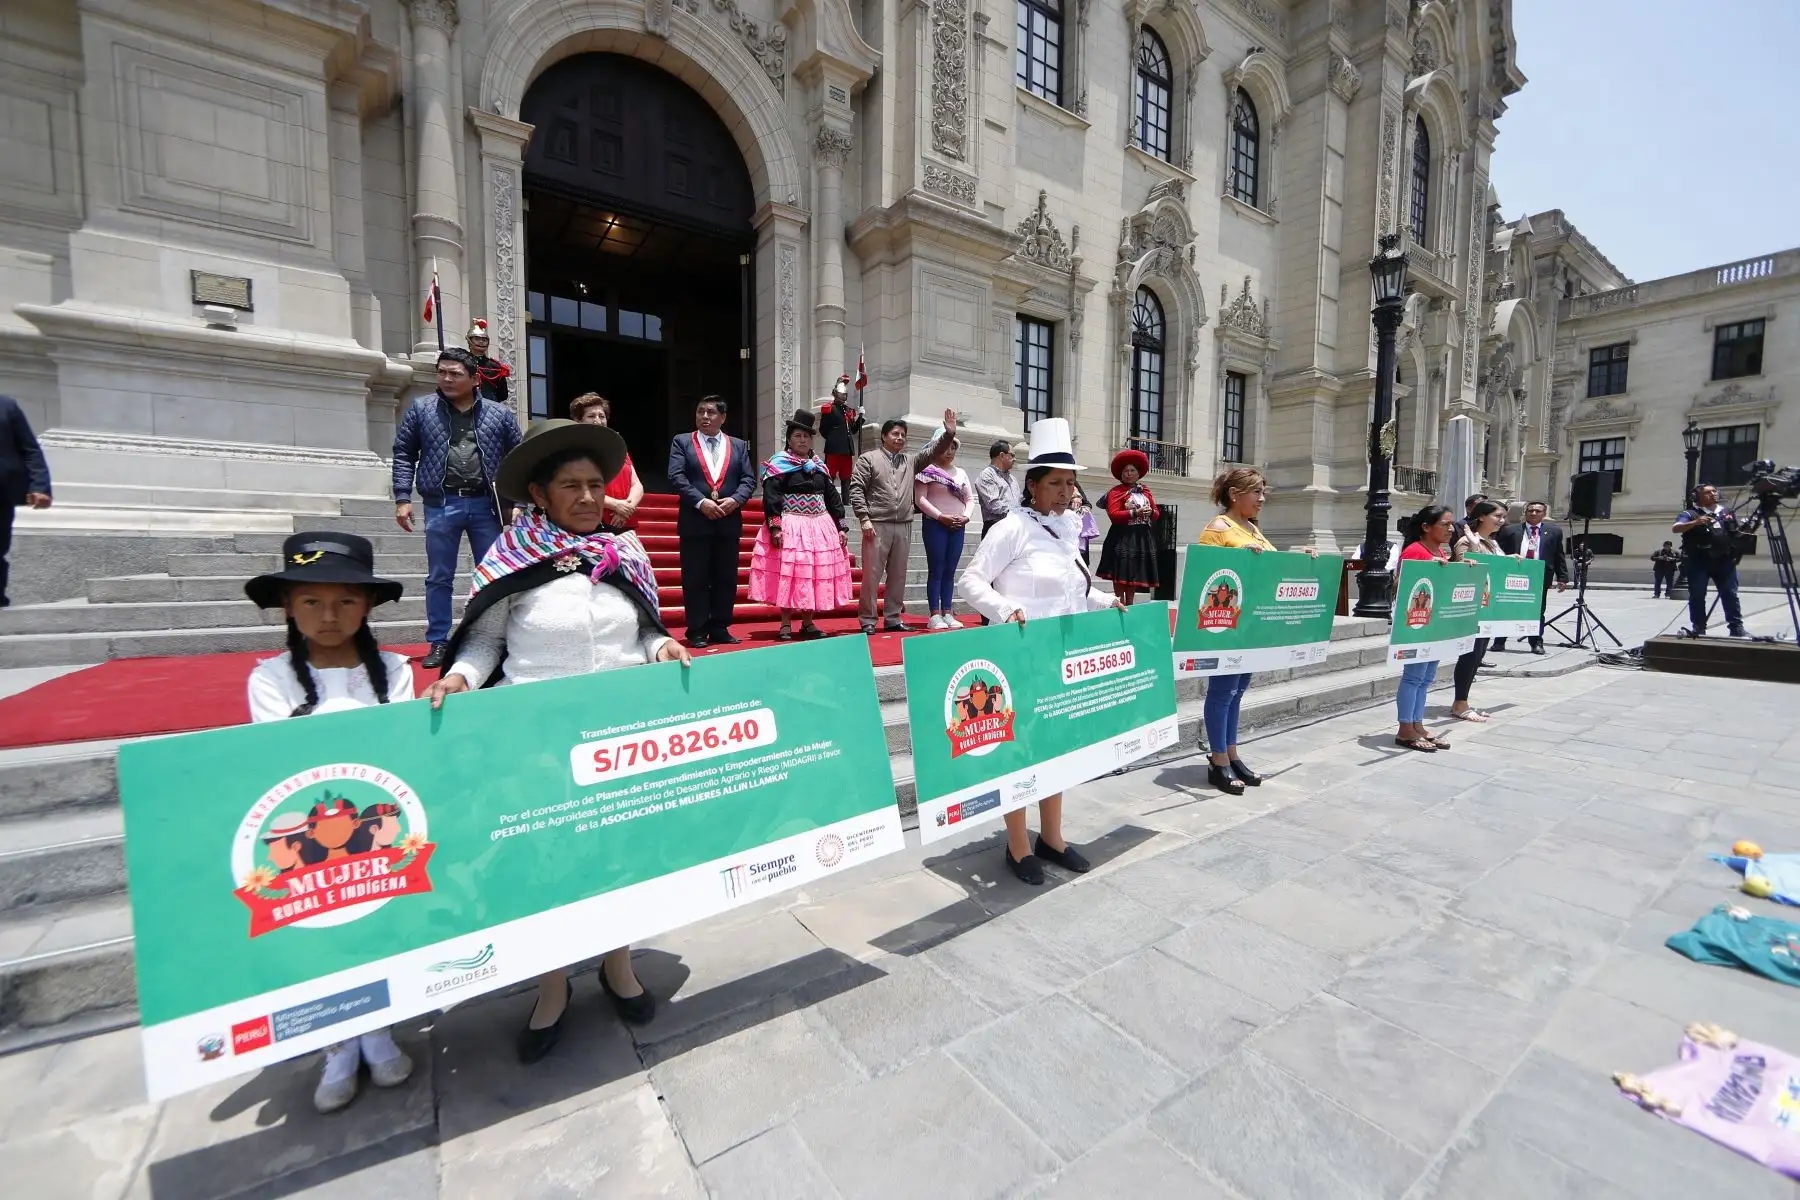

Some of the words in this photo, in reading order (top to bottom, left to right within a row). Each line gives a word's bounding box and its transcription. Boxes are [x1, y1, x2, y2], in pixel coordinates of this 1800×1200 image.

[1066, 651, 1131, 678] S/125,568.90
[580, 720, 645, 740] Transferencia
[647, 711, 695, 727] económica
[697, 708, 711, 720] por
[713, 705, 720, 714] el
[722, 702, 748, 713] monto
[750, 699, 762, 708] de:
[964, 717, 1000, 737] MUJER
[593, 719, 759, 773] S/70,826.40
[490, 823, 530, 842] (PEEM)
[532, 819, 545, 831] de
[548, 808, 598, 828] Agroideas
[600, 803, 614, 814] del
[616, 793, 661, 809] Ministerio
[664, 788, 674, 798] de
[676, 778, 719, 795] Desarrollo
[721, 771, 750, 785] Agrario
[751, 771, 756, 779] y
[757, 764, 780, 776] Riego
[781, 756, 817, 769] (MIDAGRI)
[823, 748, 841, 759] favor
[500, 814, 518, 825] Por
[521, 810, 530, 820] el
[532, 800, 580, 818] concepto
[582, 795, 594, 806] de
[596, 787, 628, 802] Planes
[630, 784, 642, 794] de
[643, 767, 717, 791] Emprendimiento
[718, 766, 724, 774] y
[725, 750, 792, 771] Empoderamiento
[794, 747, 803, 755] de
[804, 744, 811, 752] la
[811, 740, 833, 752] Mujer
[246, 767, 367, 829] EMPRENDIMIENTO
[374, 772, 389, 785] DE
[393, 784, 408, 799] LA
[575, 823, 588, 833] de
[589, 819, 598, 829] la
[600, 802, 663, 827] ASOCIACIÓN
[665, 800, 678, 810] DE
[679, 789, 721, 807] MUJERES
[722, 781, 749, 796] ALLIN
[749, 771, 789, 789] LLAMKAY
[949, 810, 960, 818] PERÚ
[287, 856, 391, 898] MUJER
[749, 853, 795, 876] Siempre
[768, 864, 797, 882] pueblo
[272, 897, 321, 921] RURAL
[327, 892, 335, 904] E
[340, 875, 407, 900] INDÍGENA
[425, 965, 497, 994] AGROIDEAS
[275, 1003, 323, 1022] Ministerio
[339, 996, 371, 1011] Agrario
[234, 1024, 268, 1044] PERÚ
